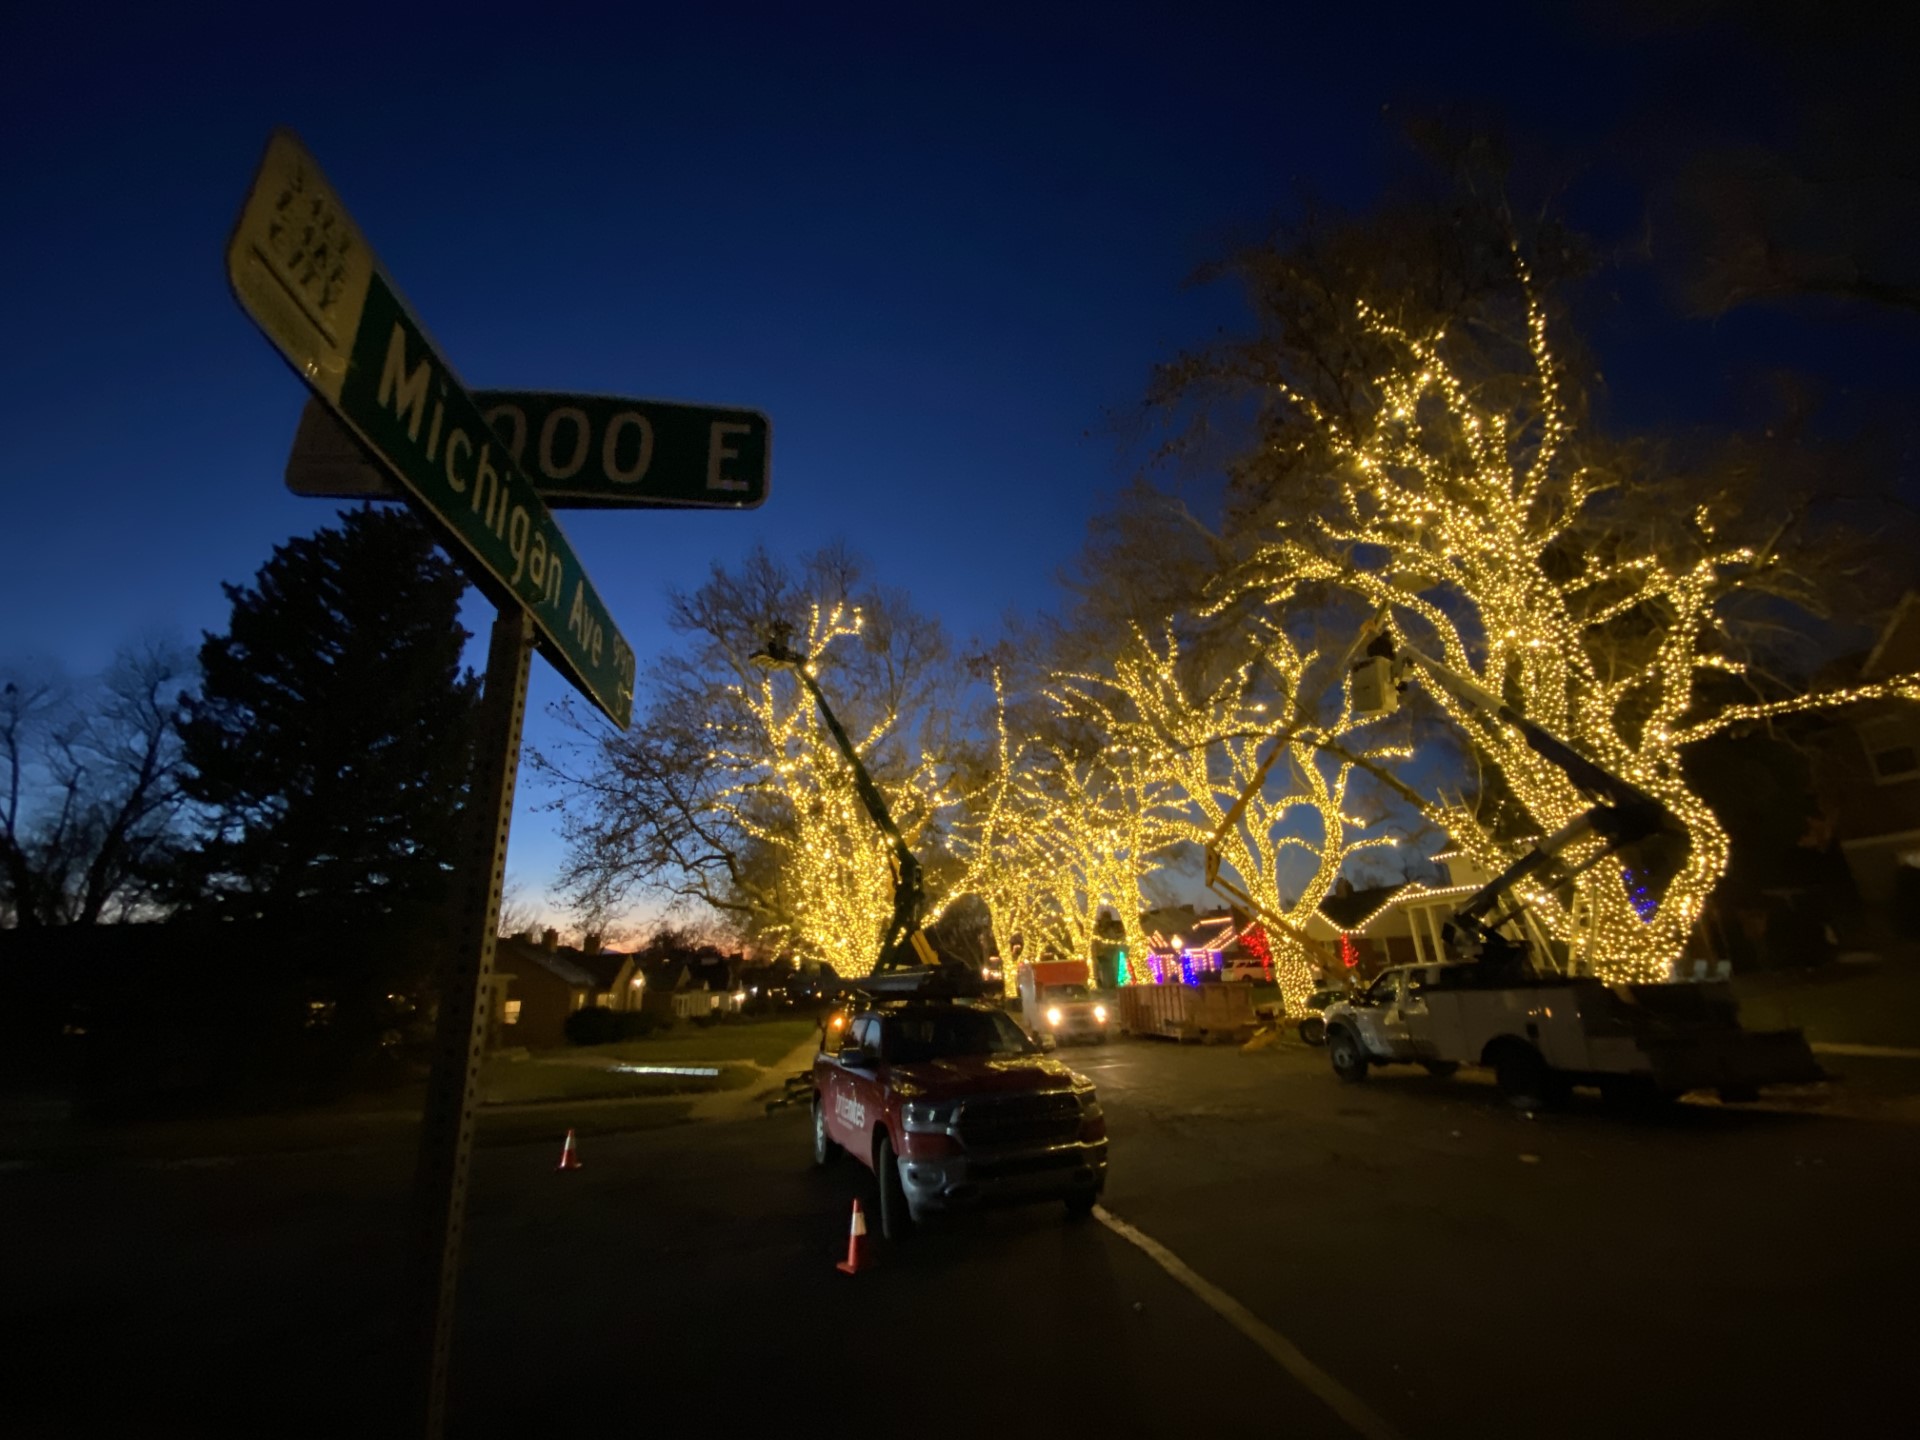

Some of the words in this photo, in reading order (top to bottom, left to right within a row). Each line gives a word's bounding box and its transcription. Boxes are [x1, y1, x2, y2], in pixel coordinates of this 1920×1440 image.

[377, 321, 562, 609] Michigan
[568, 579, 603, 668] Ave
[706, 420, 751, 491] E
